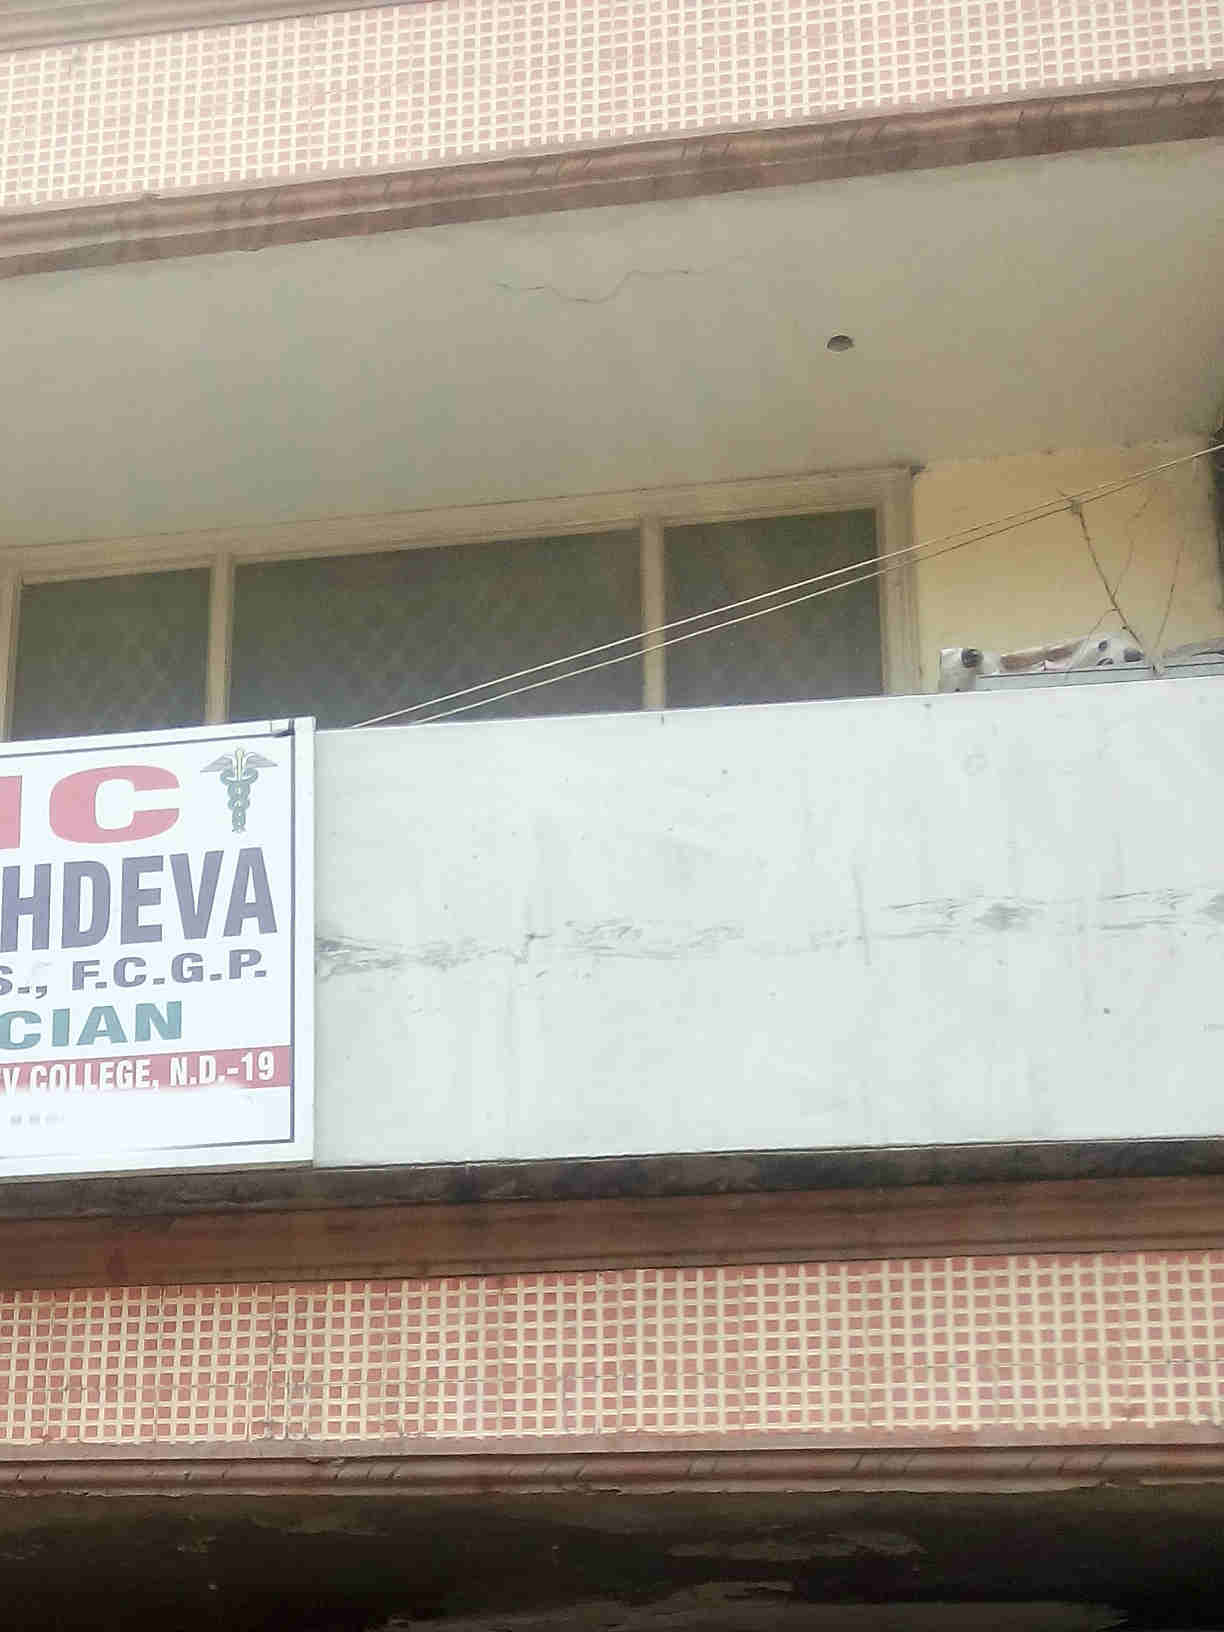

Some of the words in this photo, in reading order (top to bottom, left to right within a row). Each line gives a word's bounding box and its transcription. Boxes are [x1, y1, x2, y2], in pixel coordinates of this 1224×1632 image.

[72, 948, 267, 991] F.C.G.P.
[30, 1058, 160, 1092] COLLEGE,
[170, 1050, 275, 1086] N.D.-19
